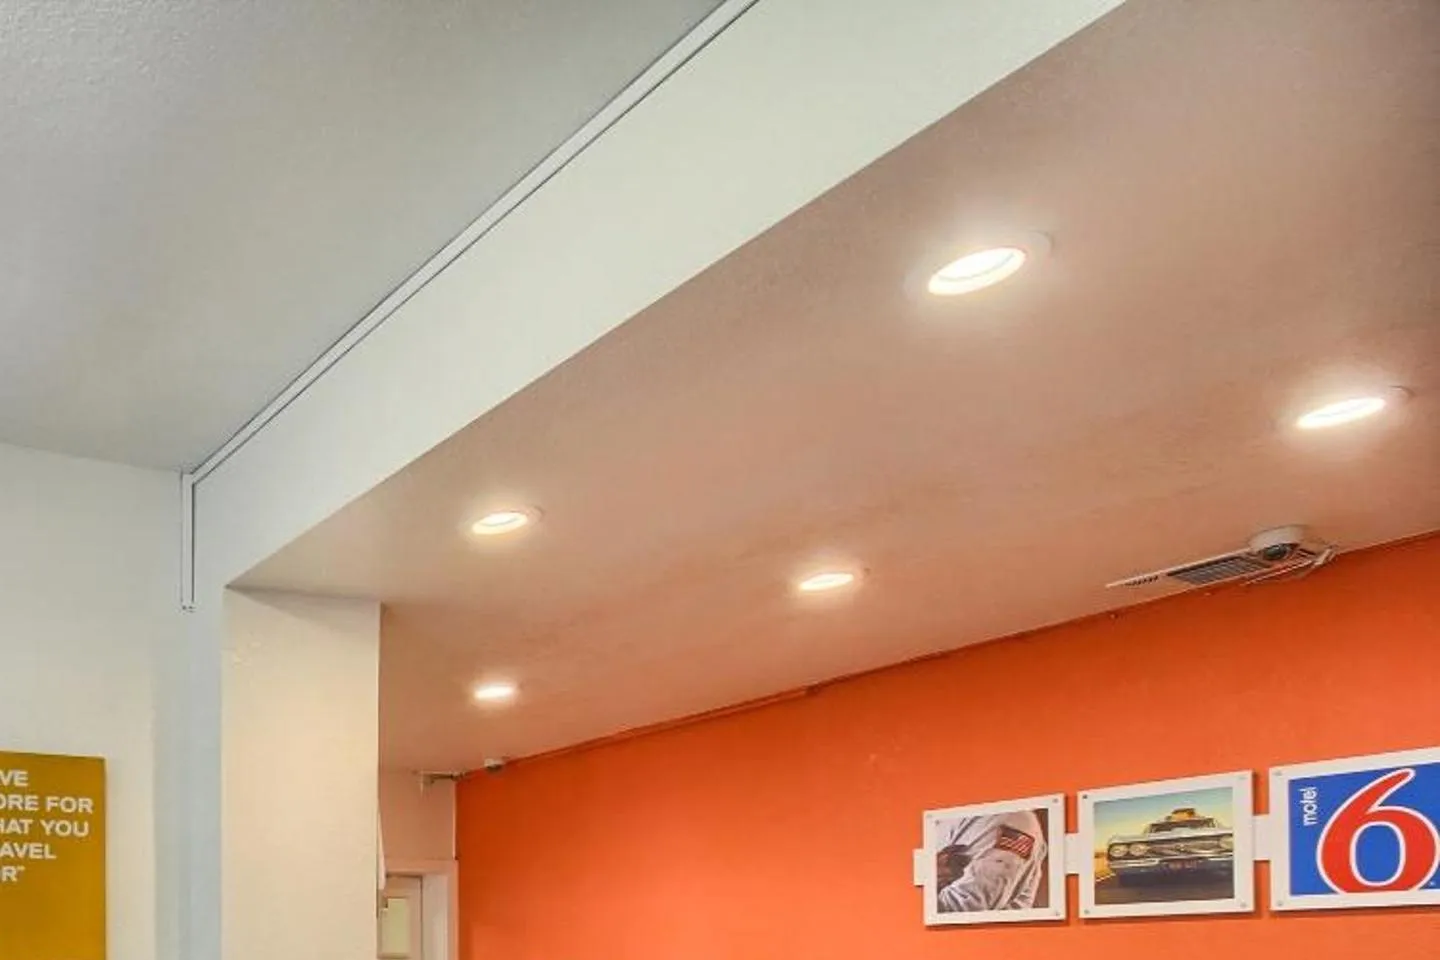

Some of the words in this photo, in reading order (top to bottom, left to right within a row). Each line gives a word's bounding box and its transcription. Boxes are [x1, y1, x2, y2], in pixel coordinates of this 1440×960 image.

[45, 796, 94, 814] FOR
[39, 820, 89, 838] YOU
[1298, 787, 1318, 826] motel
[1316, 768, 1440, 895] 6
